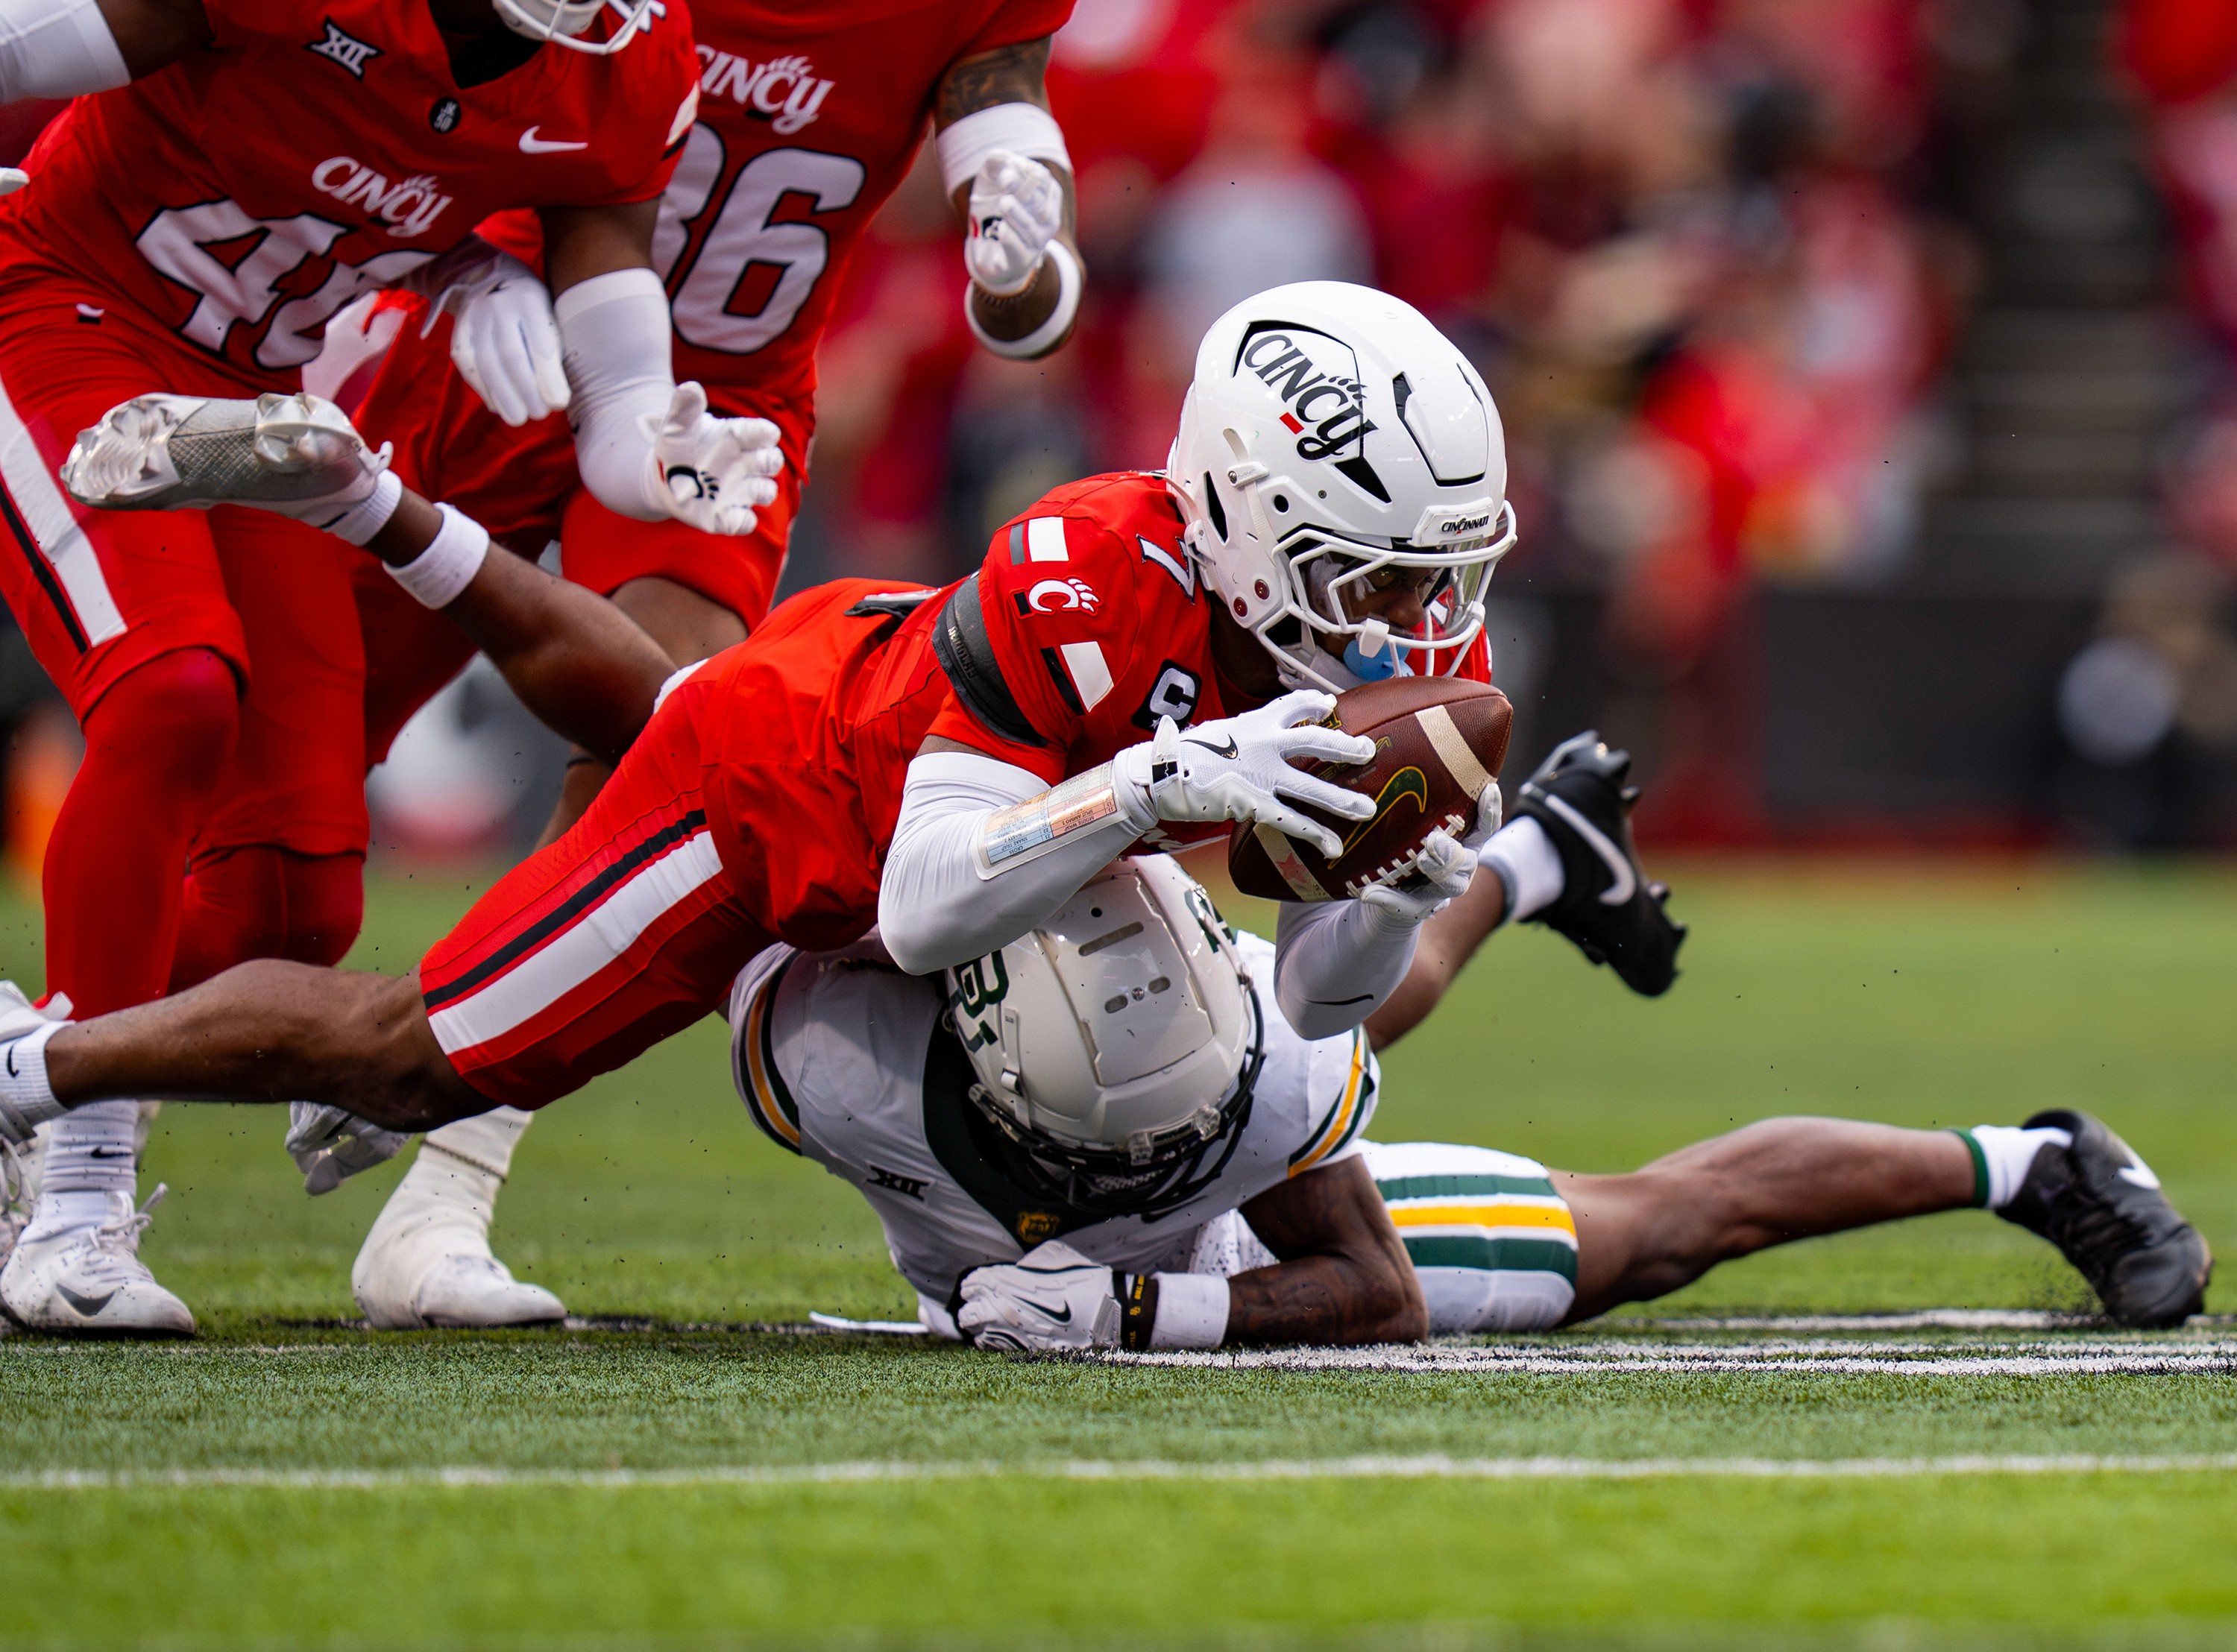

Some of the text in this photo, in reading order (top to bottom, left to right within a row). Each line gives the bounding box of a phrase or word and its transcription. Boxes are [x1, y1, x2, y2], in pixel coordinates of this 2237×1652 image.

[307, 19, 381, 78] XII
[312, 156, 453, 238] CINCY
[1245, 335, 1379, 460] CINCY
[1441, 514, 1490, 532] CINCINNATI
[1136, 534, 1195, 605] 7
[1149, 668, 1195, 721] C
[1063, 822, 1077, 831] WASP
[1065, 814, 1081, 823] AMMO
[1077, 816, 1094, 825] MOOSE
[1008, 845, 1023, 854] CROSS
[1013, 836, 1028, 845] SNAKE
[866, 1165, 931, 1202] XII
